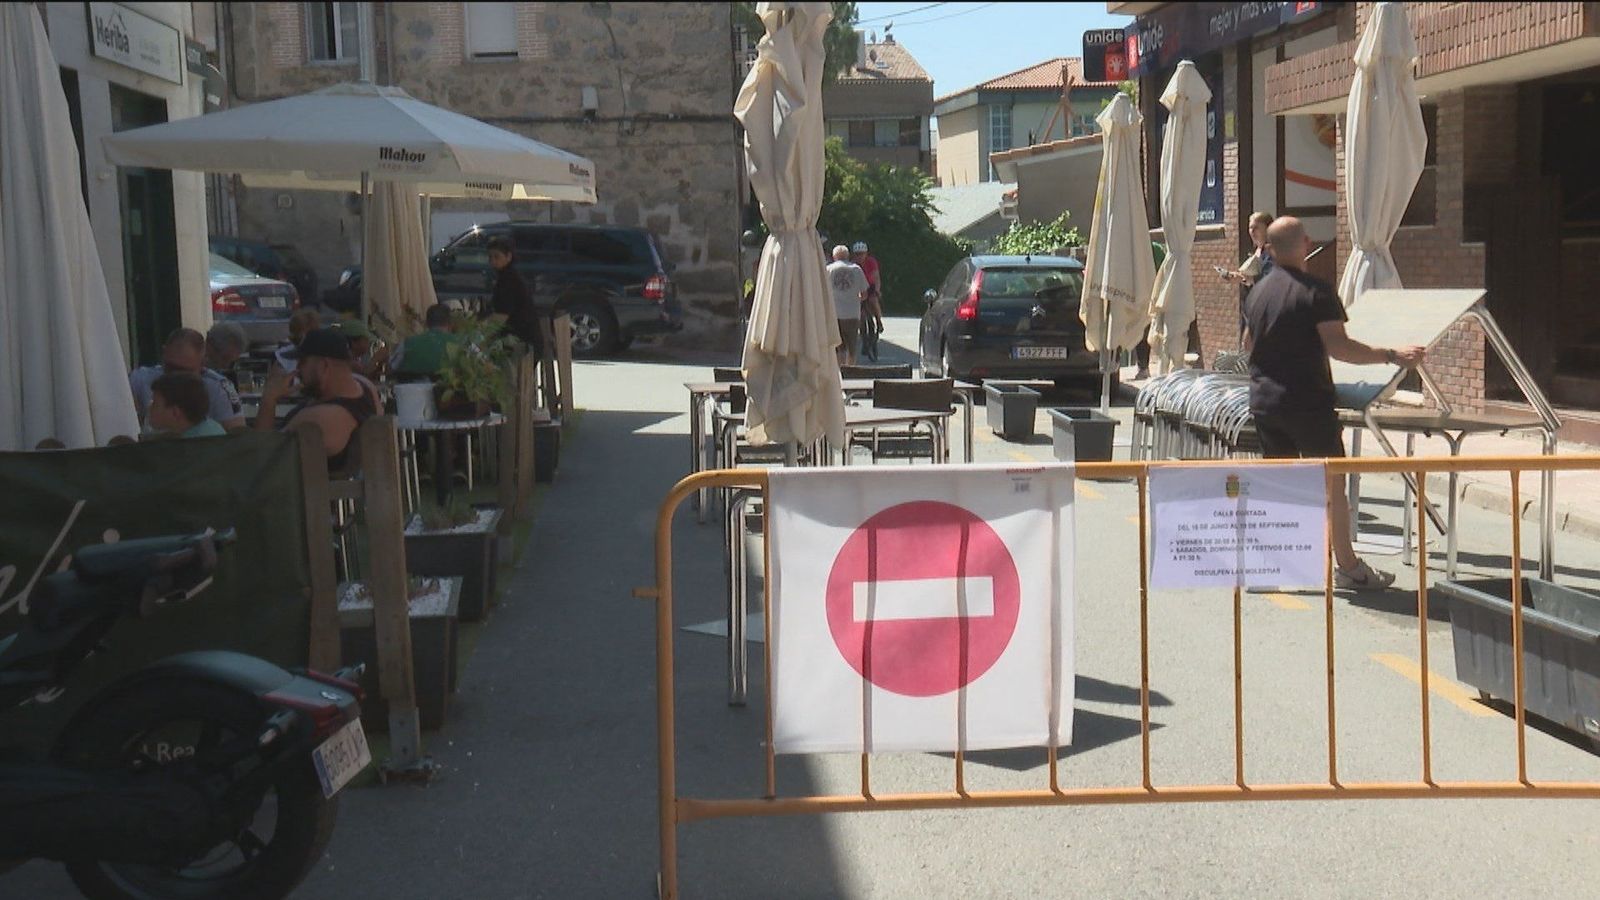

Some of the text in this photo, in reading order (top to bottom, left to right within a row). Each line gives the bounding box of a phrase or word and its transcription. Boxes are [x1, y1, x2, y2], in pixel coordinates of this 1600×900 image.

[1086, 29, 1124, 43] unide
[1137, 19, 1164, 56] unide
[1259, 521, 1299, 529] SEPTIEMBRE
